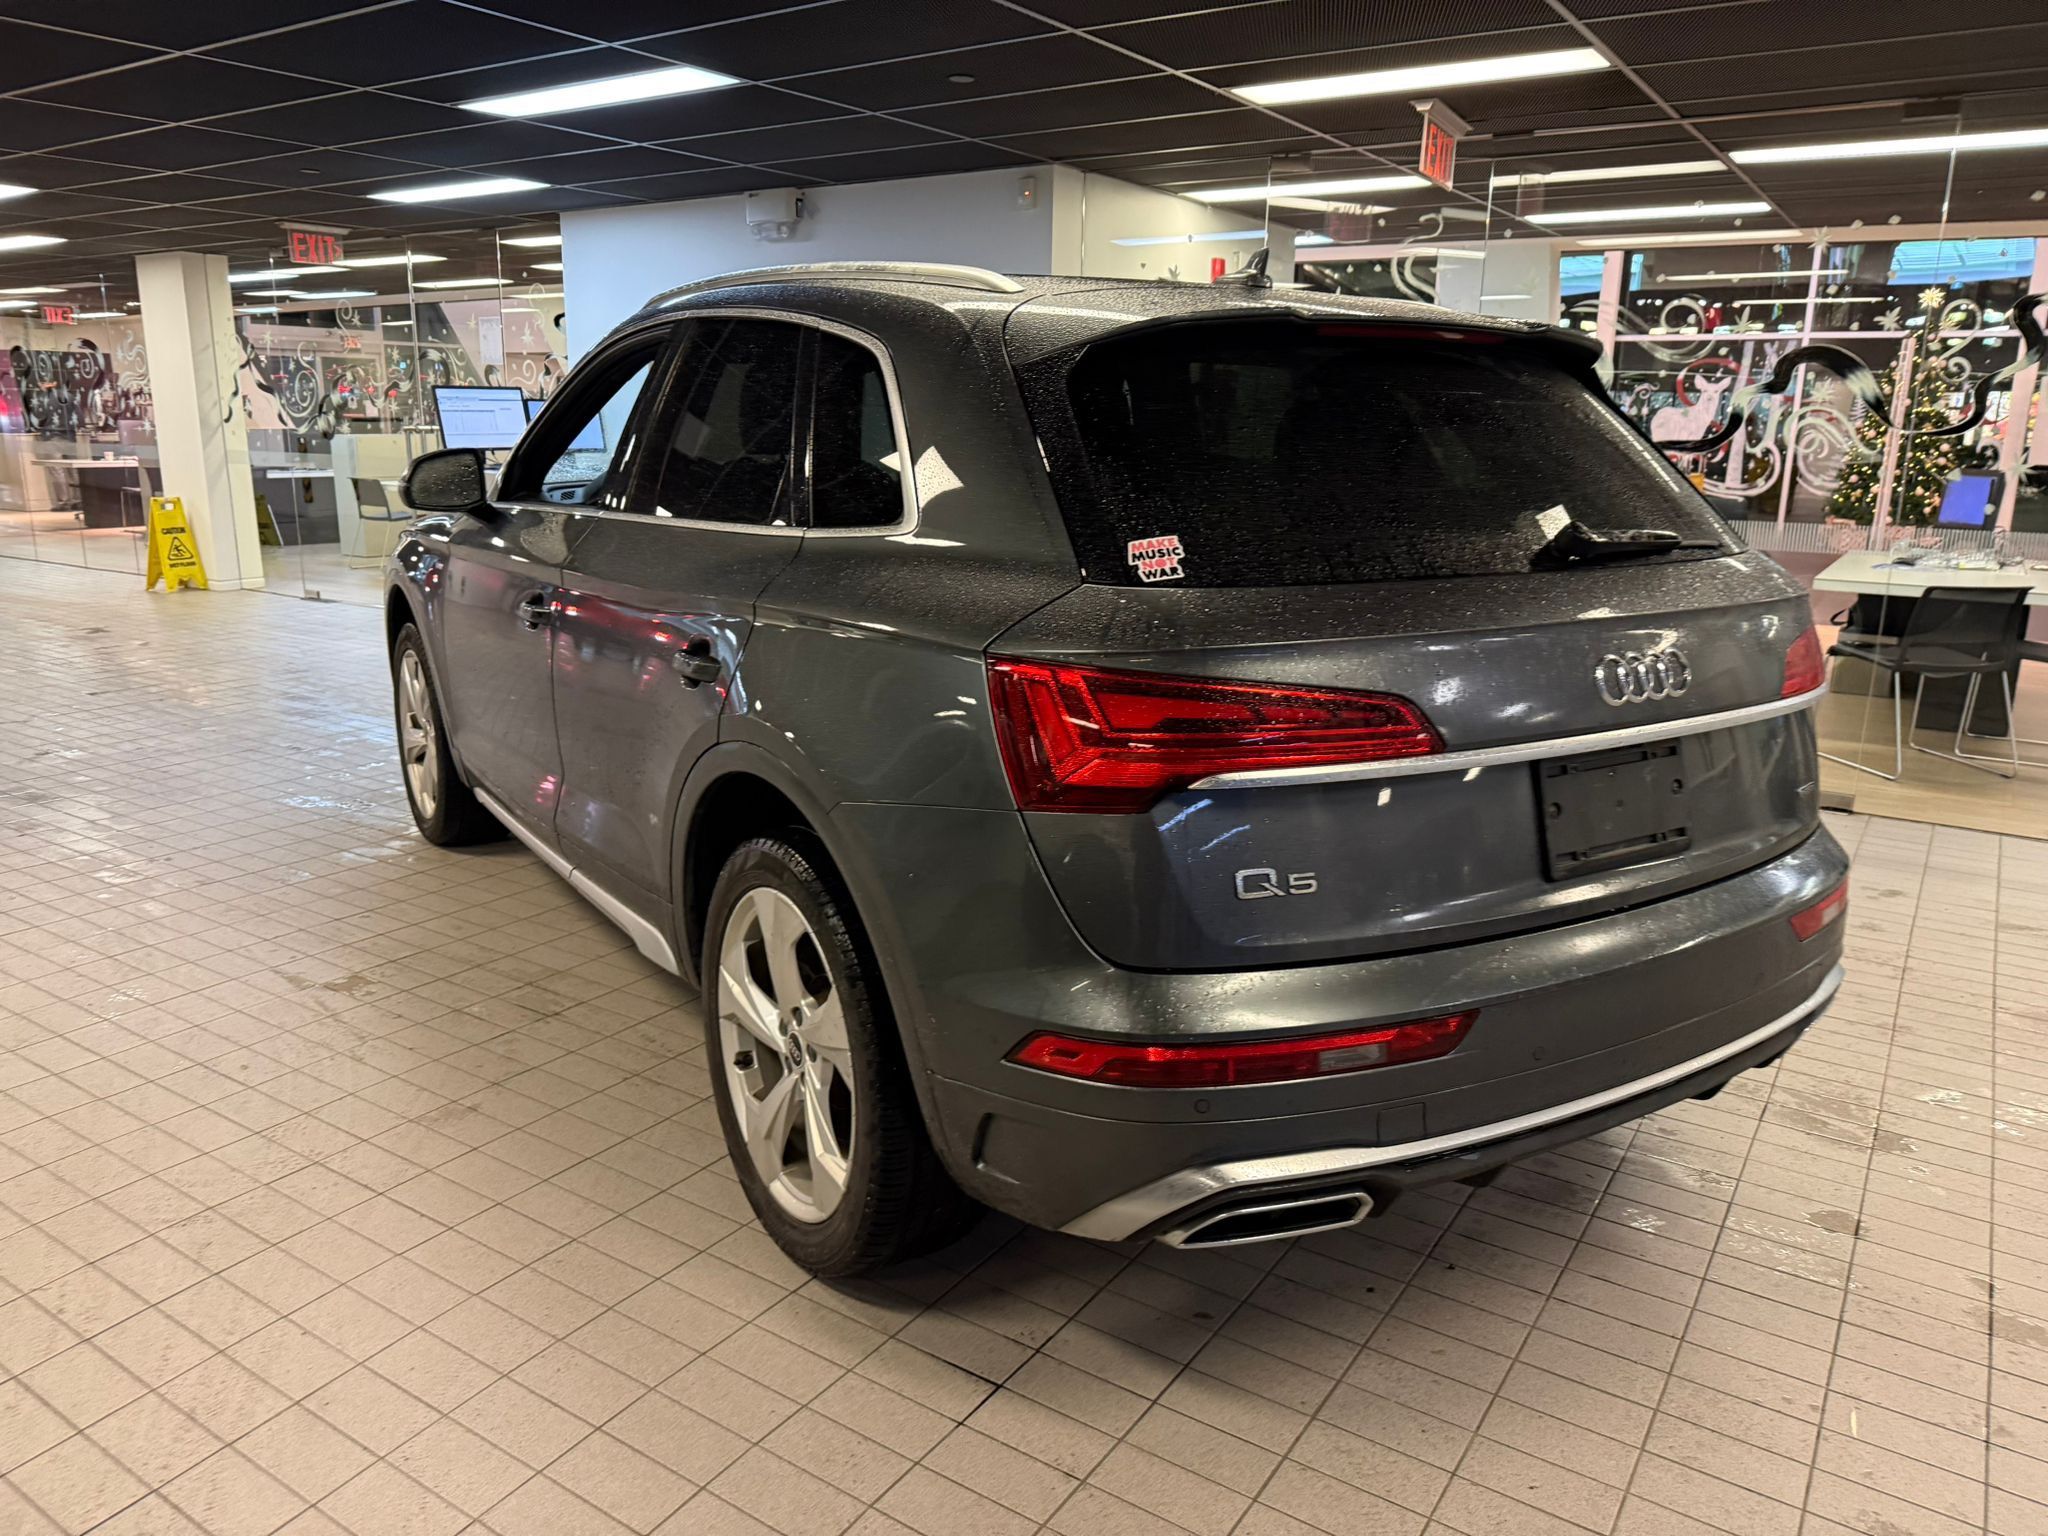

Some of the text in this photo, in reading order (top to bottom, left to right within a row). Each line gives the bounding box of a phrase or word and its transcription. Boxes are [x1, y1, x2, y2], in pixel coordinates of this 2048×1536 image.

[1426, 123, 1454, 182] EXIT
[292, 232, 336, 263] EXIT
[1131, 538, 1176, 552] MAKE
[1132, 546, 1182, 563] MUSIC
[1141, 556, 1175, 570] NOT
[1142, 566, 1181, 580] WAR
[1235, 868, 1319, 900] Q5
